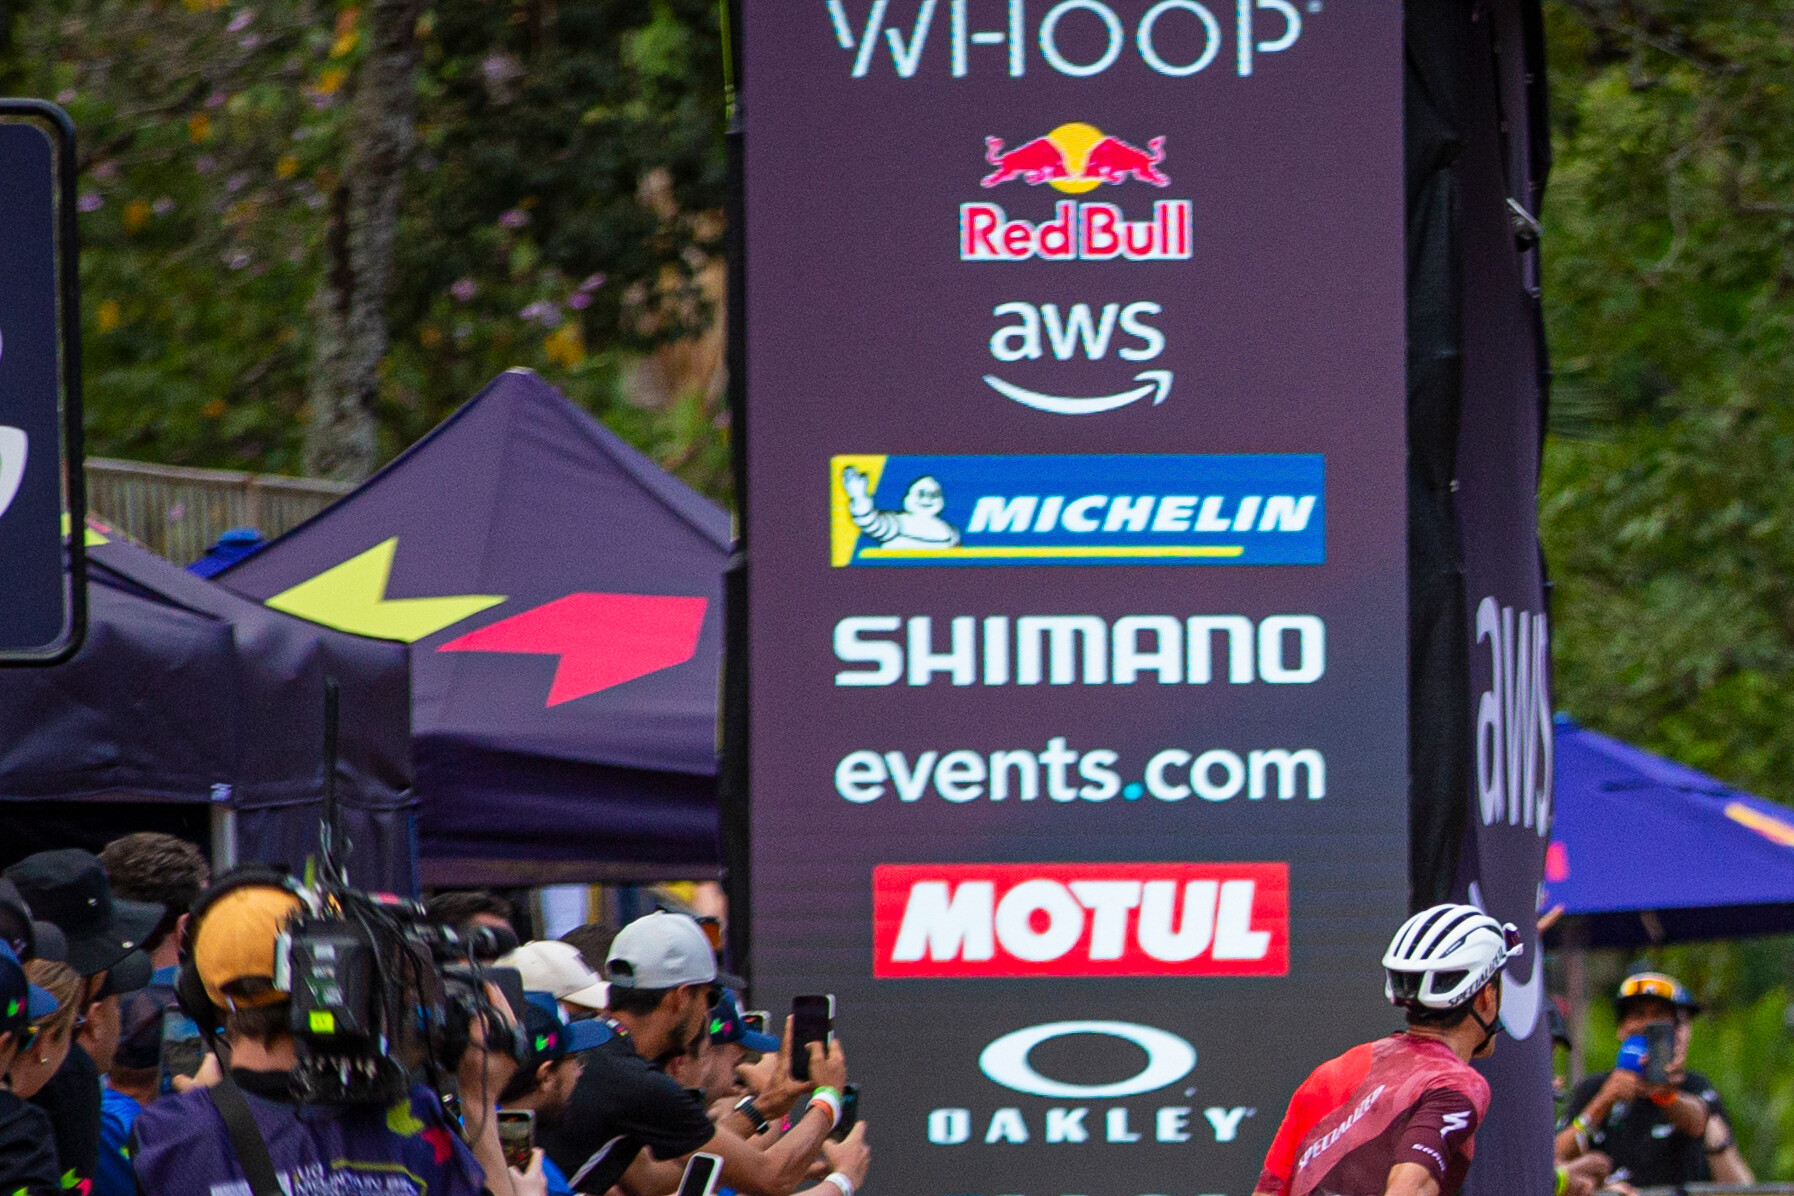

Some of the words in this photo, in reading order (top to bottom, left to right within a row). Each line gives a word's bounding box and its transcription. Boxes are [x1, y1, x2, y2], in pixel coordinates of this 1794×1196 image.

[826, 0, 1304, 78] WHOOP
[962, 202, 1075, 259] Red
[1080, 202, 1191, 259] Bull
[989, 302, 1166, 362] aws
[967, 495, 1317, 534] MICHELIN
[833, 616, 1326, 687] SHIMANO
[1476, 596, 1551, 837] aws
[834, 737, 1326, 804] events.com
[891, 879, 1271, 963] MOTUL
[928, 1108, 1249, 1145] OAKLEY
[1299, 1084, 1386, 1174] SPECIALIZED
